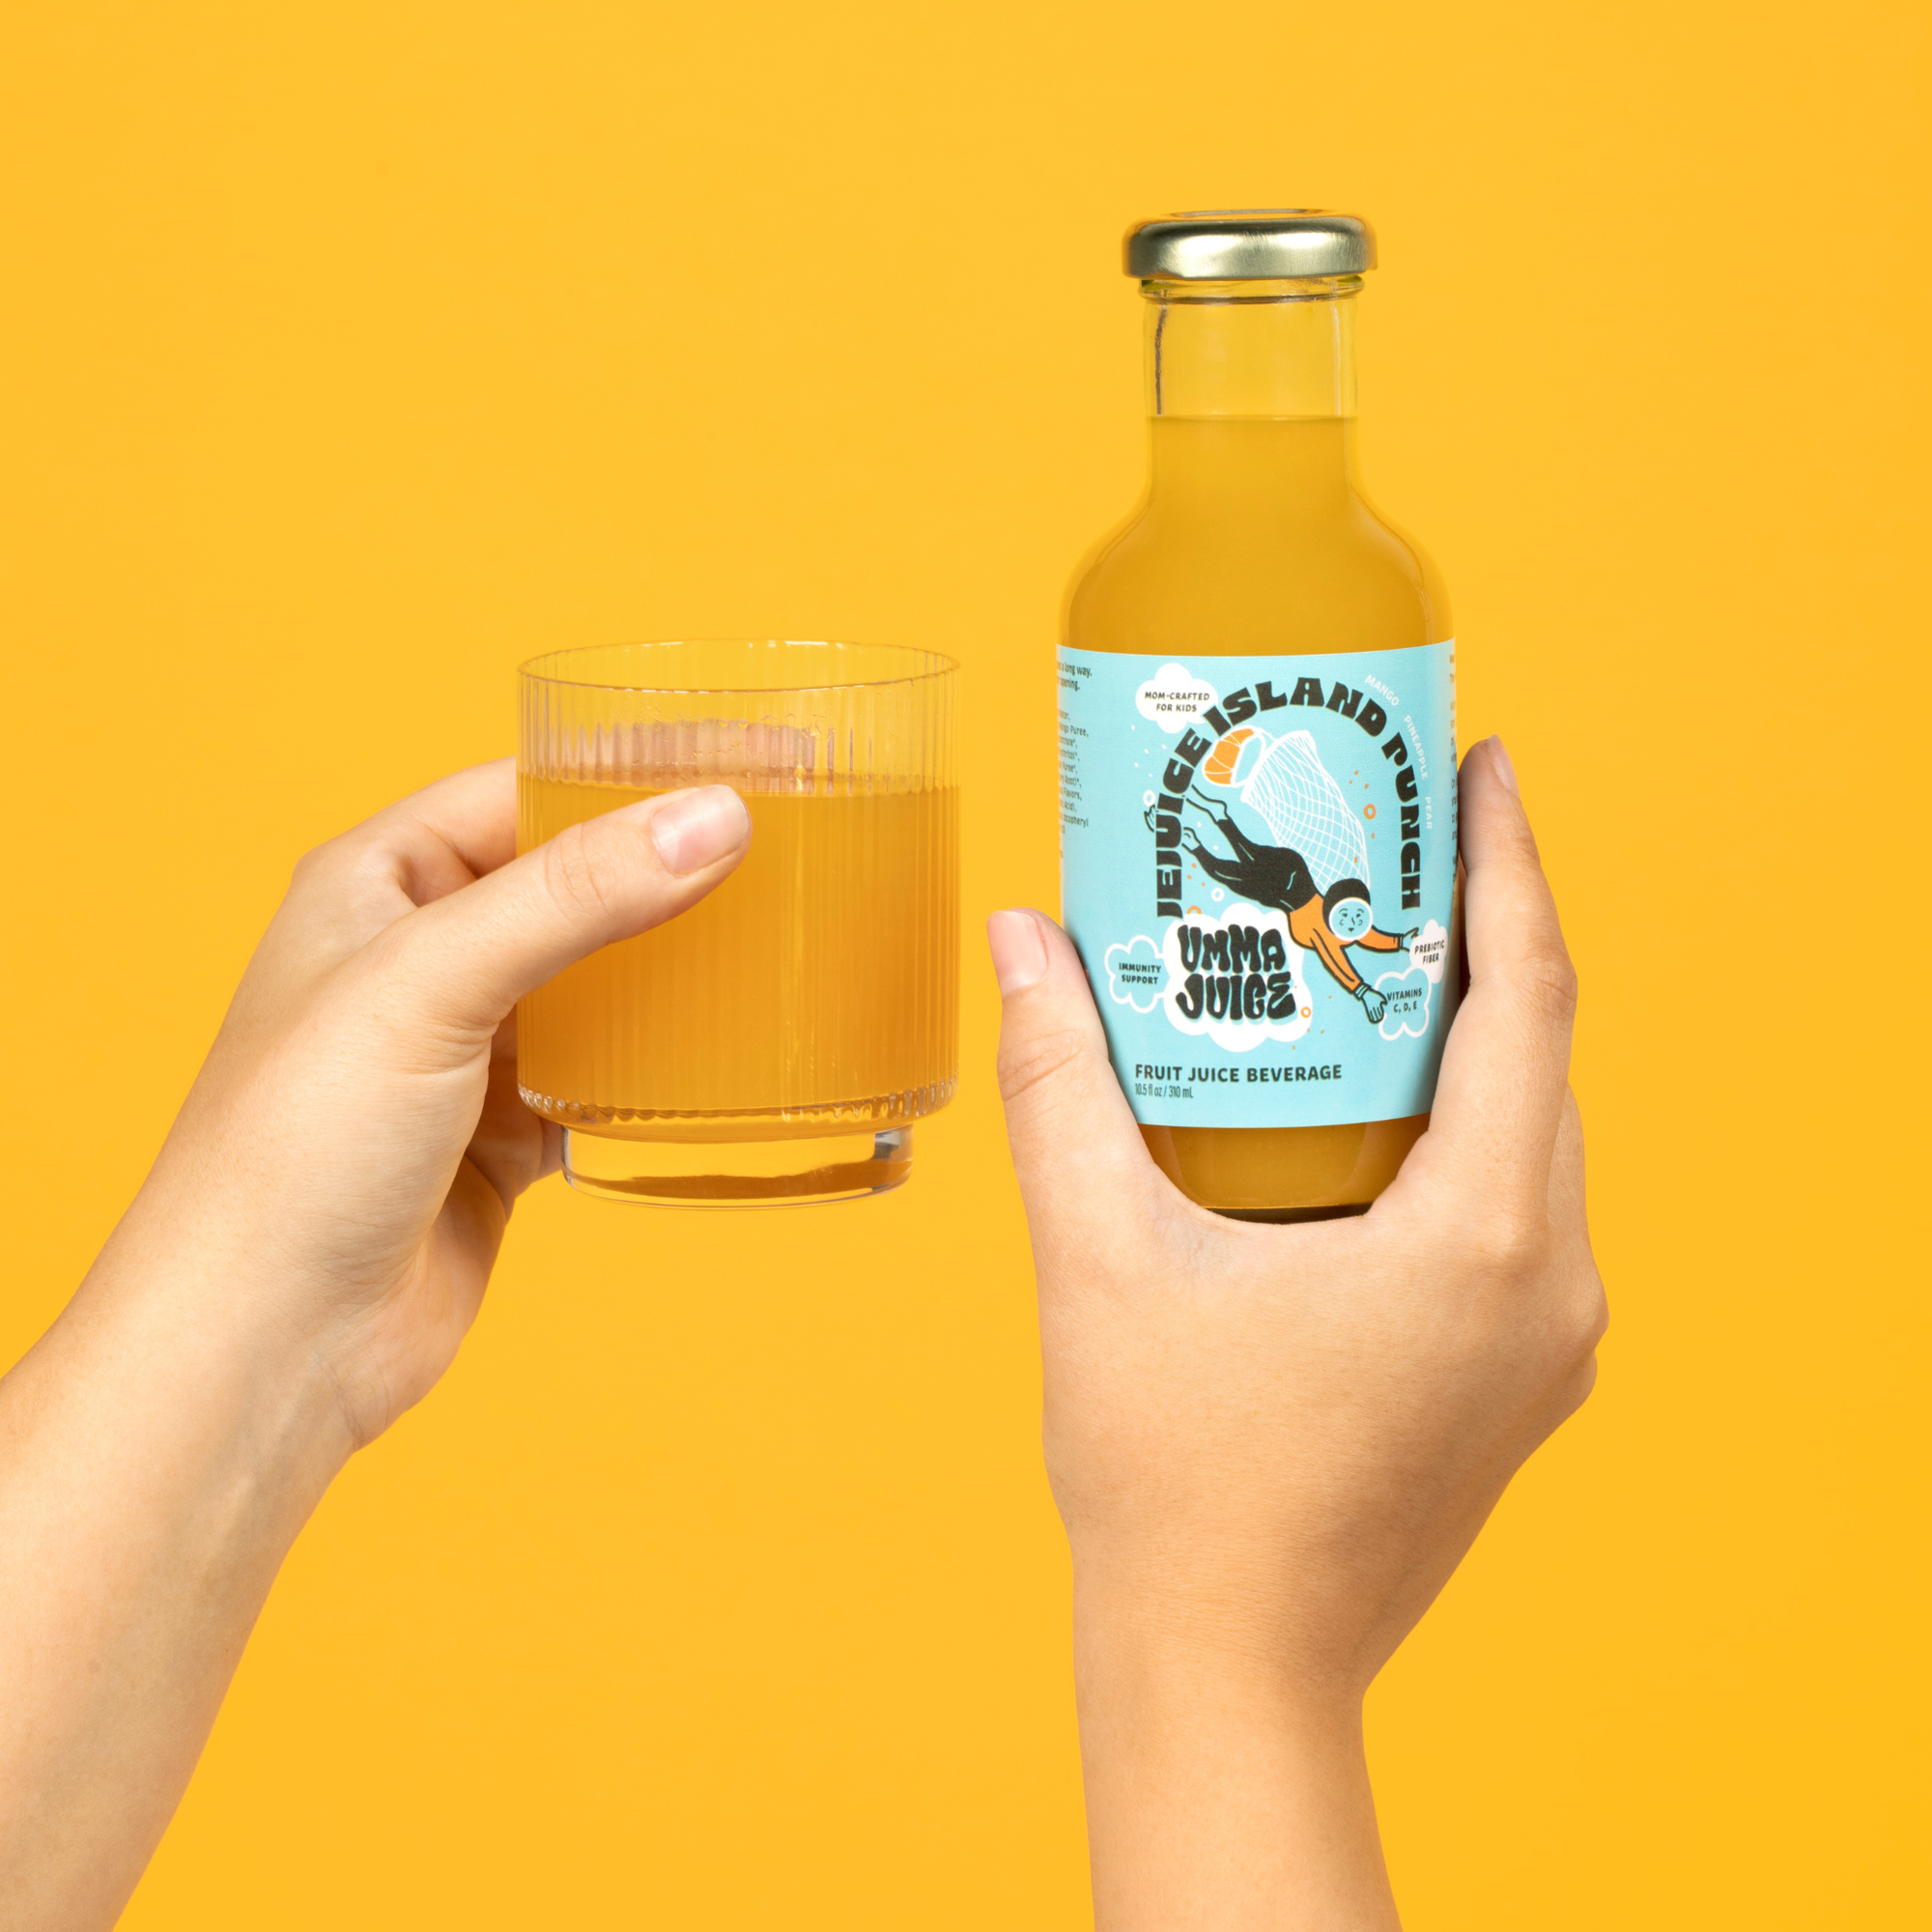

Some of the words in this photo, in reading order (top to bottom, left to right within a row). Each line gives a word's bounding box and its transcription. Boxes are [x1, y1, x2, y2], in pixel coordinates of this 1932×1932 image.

[1077, 667, 1093, 678] way.
[1145, 691, 1210, 701] MOM-CRAFTED
[1364, 674, 1400, 706] MANGO
[1156, 703, 1173, 712] FOR
[1176, 703, 1197, 713] KIDS
[1070, 724, 1090, 738] Puree,
[1404, 715, 1429, 780] PINEAPPLE
[1155, 727, 1213, 919] JEJUICE
[1203, 677, 1387, 738] ISLAND
[1381, 731, 1421, 910] PUNCH
[1177, 923, 1286, 974] UMMA
[1414, 940, 1444, 954] PREBIOTIC
[1422, 952, 1439, 965] FIBER
[1119, 962, 1161, 974] IMMUNITY
[1122, 975, 1159, 985] SUPPORT
[1175, 971, 1296, 1020] JUICE
[1386, 988, 1422, 1002] VITAMINS
[1393, 1003, 1401, 1014] C,
[1404, 1002, 1411, 1012] D,
[1412, 1001, 1417, 1010] E
[1135, 1064, 1182, 1081] FRUIT
[1187, 1066, 1239, 1083] JUICE
[1247, 1065, 1342, 1083] BEVERAGE
[1135, 1083, 1148, 1096] 10.5
[1154, 1087, 1163, 1097] oz
[1169, 1085, 1181, 1098] 310
[1182, 1086, 1194, 1099] mL
